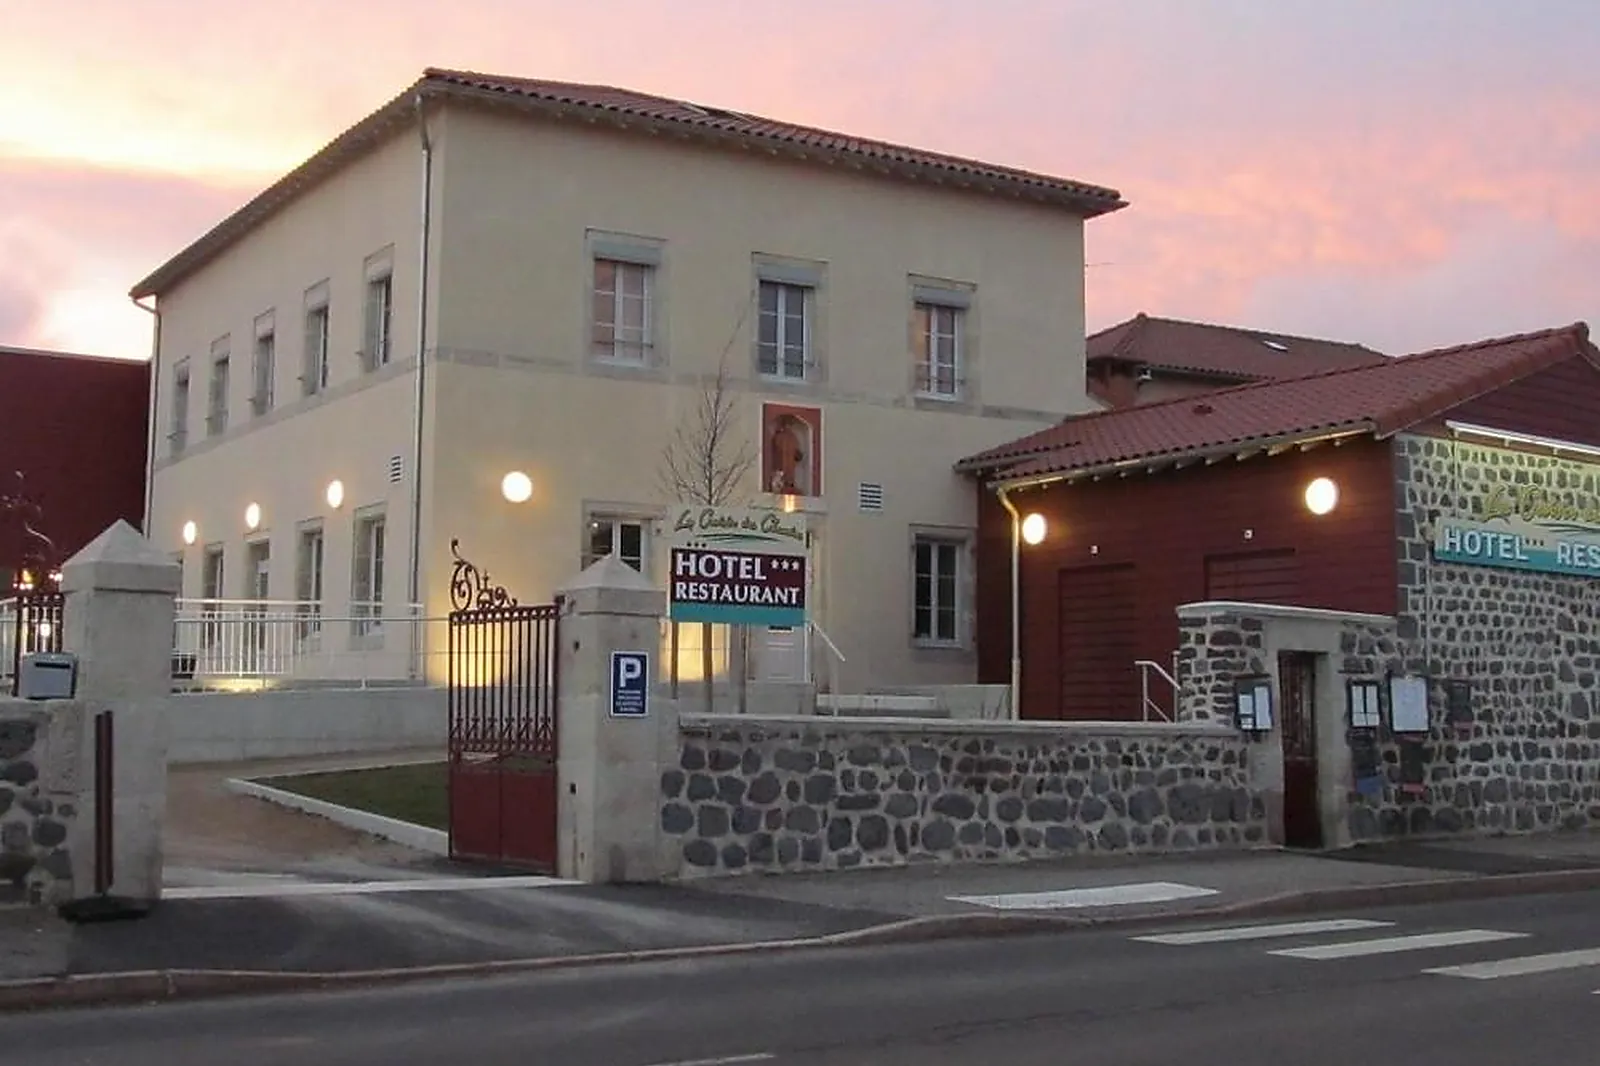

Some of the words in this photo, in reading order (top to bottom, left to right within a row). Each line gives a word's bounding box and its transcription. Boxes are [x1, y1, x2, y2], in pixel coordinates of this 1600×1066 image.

[1444, 528, 1530, 562] HOTEL
[676, 553, 767, 580] HOTEL
[676, 582, 800, 604] RESTAURANT
[620, 657, 641, 687] P
